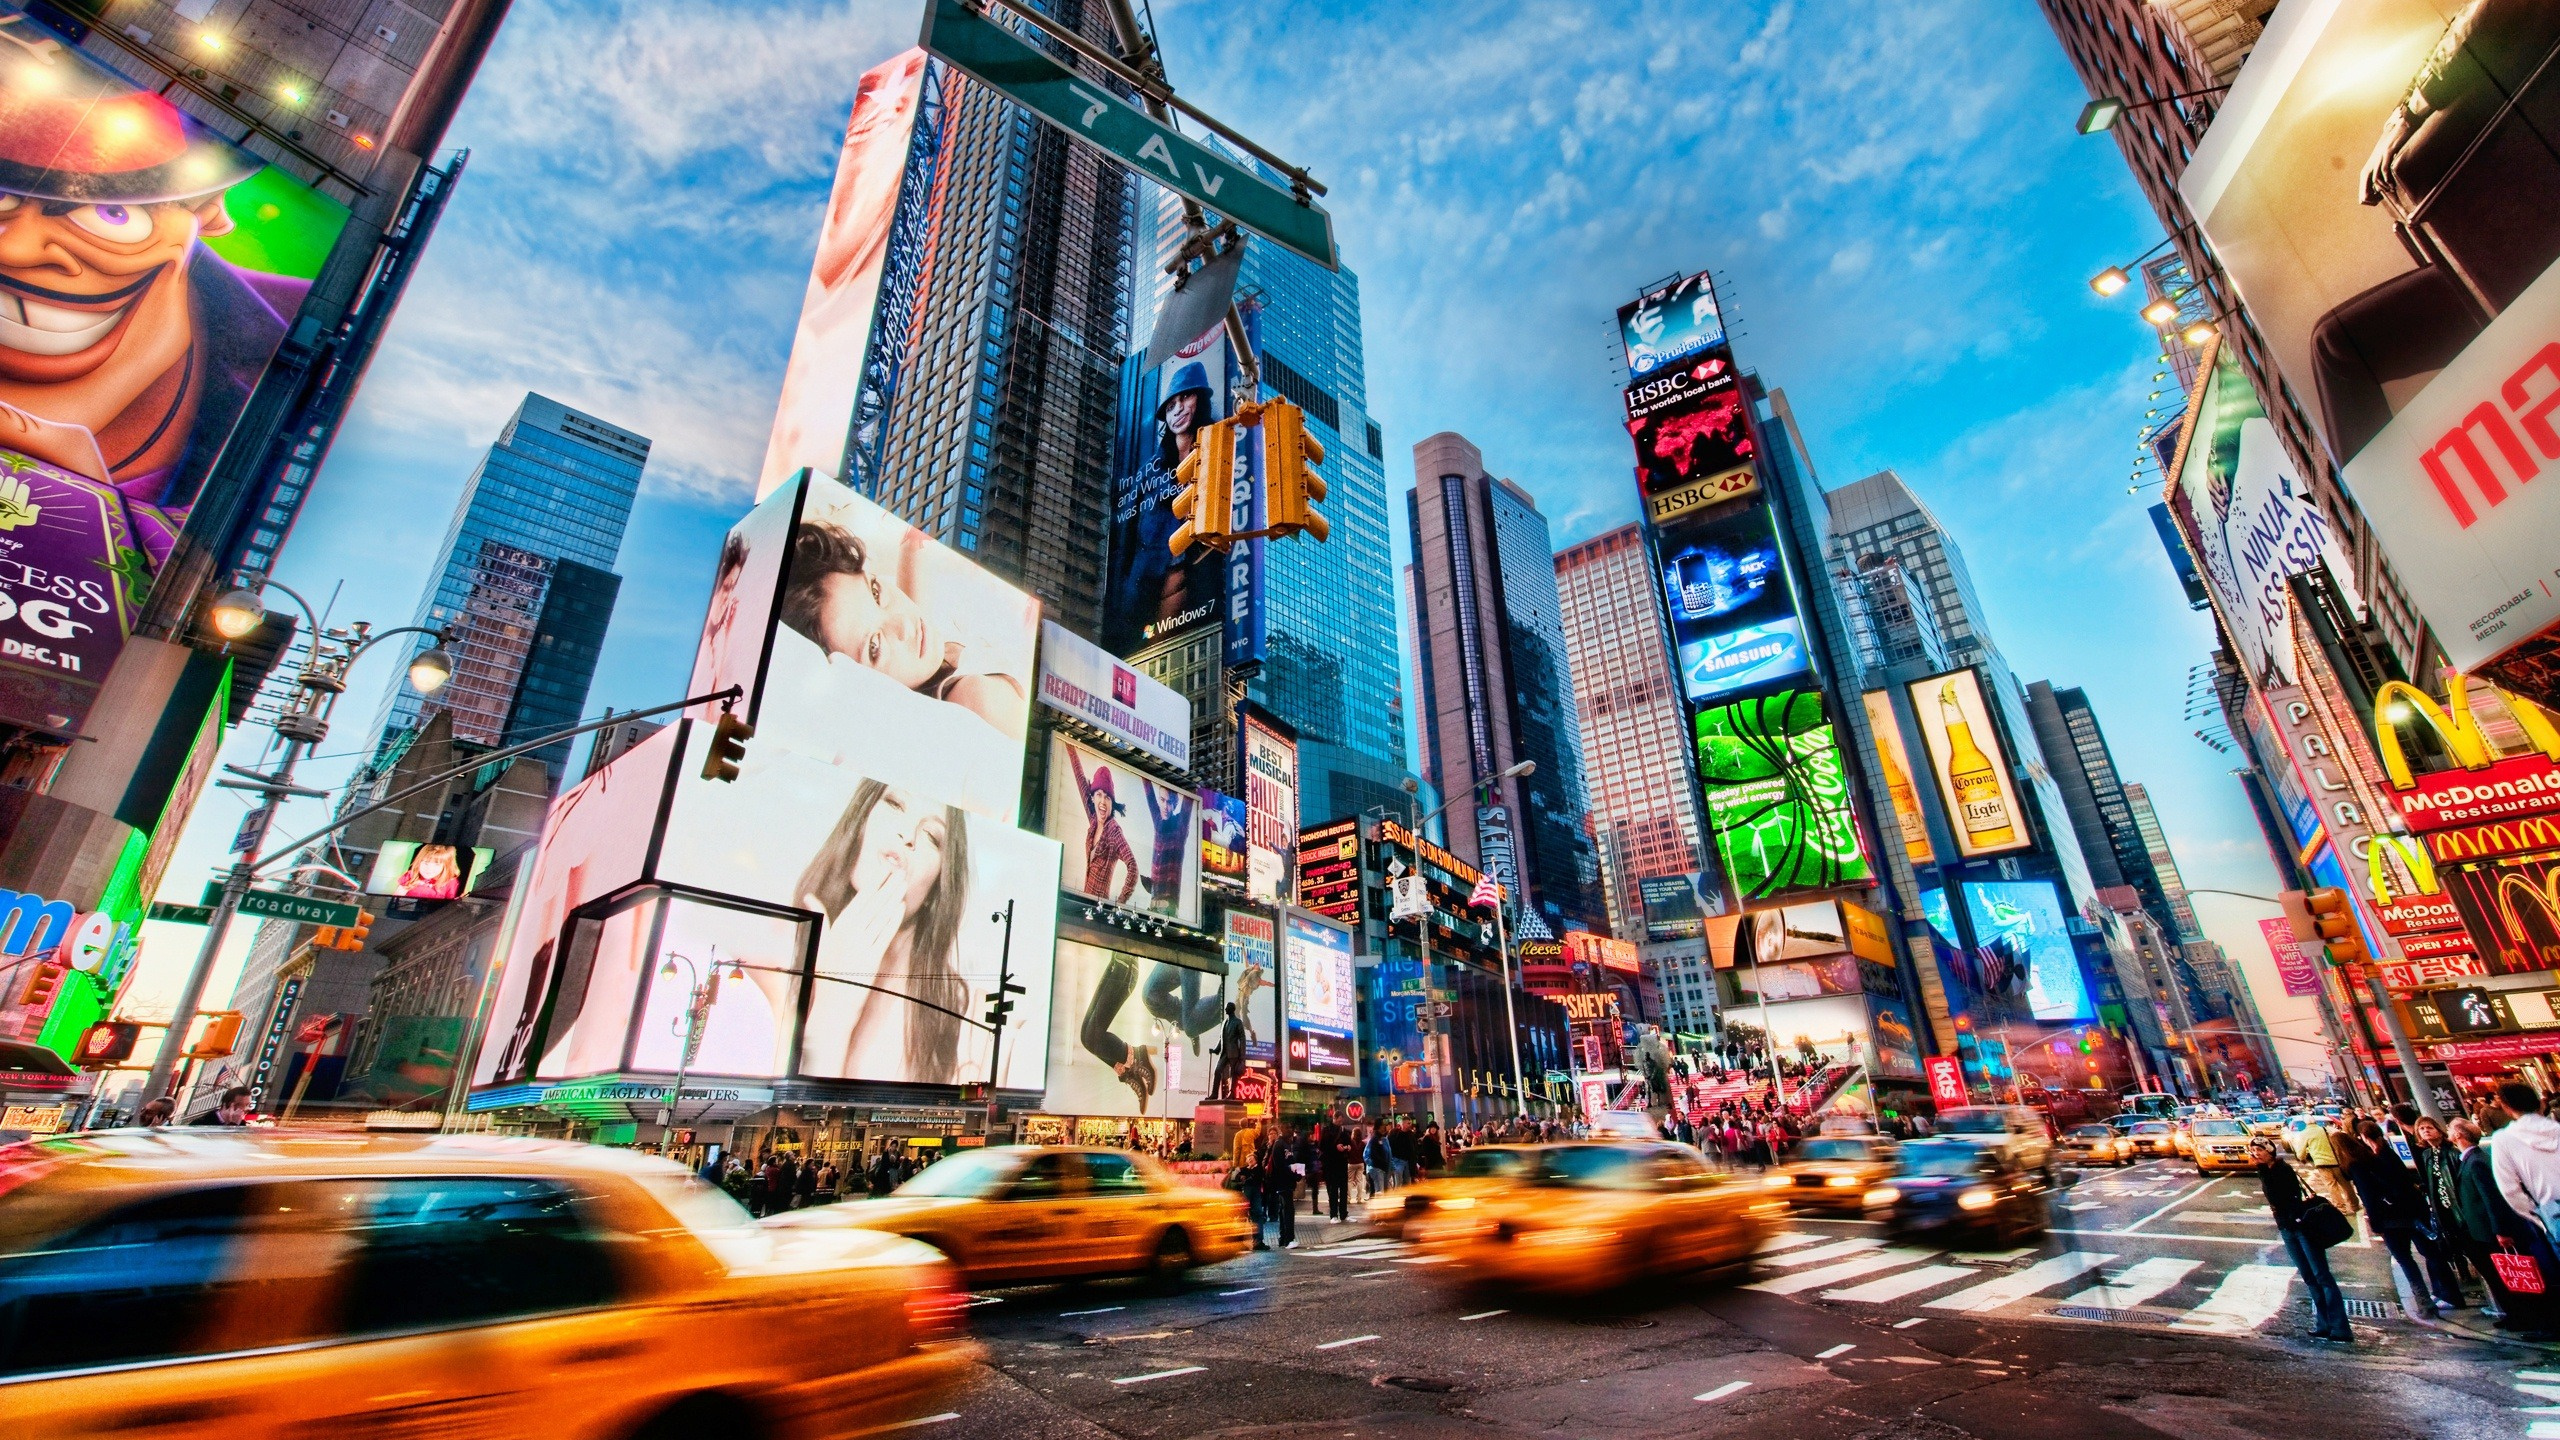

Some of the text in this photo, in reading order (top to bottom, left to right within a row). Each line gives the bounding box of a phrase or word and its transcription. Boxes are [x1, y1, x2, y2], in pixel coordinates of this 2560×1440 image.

[1069, 83, 1225, 198] 7 AV
[1656, 327, 1722, 364] Prudential
[1627, 372, 1689, 408] HSBC
[1631, 374, 1732, 419] The world's local bank
[1117, 467, 1178, 508] and Windo
[1118, 456, 1161, 492] I'm a PC
[1116, 506, 1137, 524] was
[1139, 496, 1157, 514] my
[1653, 482, 1717, 517] HSBC
[2241, 488, 2293, 584] NINJA
[1156, 599, 1216, 634] Windows 7
[2469, 588, 2533, 632] RECORDABLE
[1231, 637, 1249, 650] NYC
[2475, 619, 2508, 642] MEDIA
[2, 638, 81, 671] DEC. 11
[1704, 641, 1784, 674] SAMSUNG
[1117, 676, 1131, 697] GAP
[1044, 673, 1186, 761] READY FOR HOLIDAY CHEER
[1259, 743, 1283, 769] BEST
[1249, 753, 1293, 789] MUSICAL
[1954, 774, 1995, 791] Corona
[1250, 772, 1280, 818] BILLY
[1709, 779, 1786, 803] display powered
[1713, 789, 1786, 812] by wind energy
[1965, 801, 2002, 820] Light
[1251, 808, 1285, 854] ELLIOT
[1299, 822, 1355, 843] THOMSON REUTERS
[1299, 846, 1339, 863] STOCK INDICES
[1508, 830, 1518, 875] Chocolate
[172, 906, 183, 920] 7
[245, 894, 337, 923] roadway
[1231, 913, 1273, 942] HEIGHTS
[1228, 944, 1244, 964] BEST
[1520, 940, 1562, 956] Reese's
[2275, 942, 2300, 952] FREE
[2280, 951, 2303, 961] WIFI
[2405, 937, 2442, 952] OPEN
[2444, 935, 2460, 948] 24
[1406, 980, 1414, 990] 46
[1410, 989, 1427, 997] Stanle
[0, 1072, 93, 1083] NEW YORK MARQUIS
[1235, 1080, 1267, 1100] ROXY
[1458, 1067, 1508, 1097] 1585
[1933, 1060, 1957, 1099] tkts
[543, 1086, 739, 1101] AMERICAN EAGLE OUTERS
[2507, 1277, 2519, 1289] of
